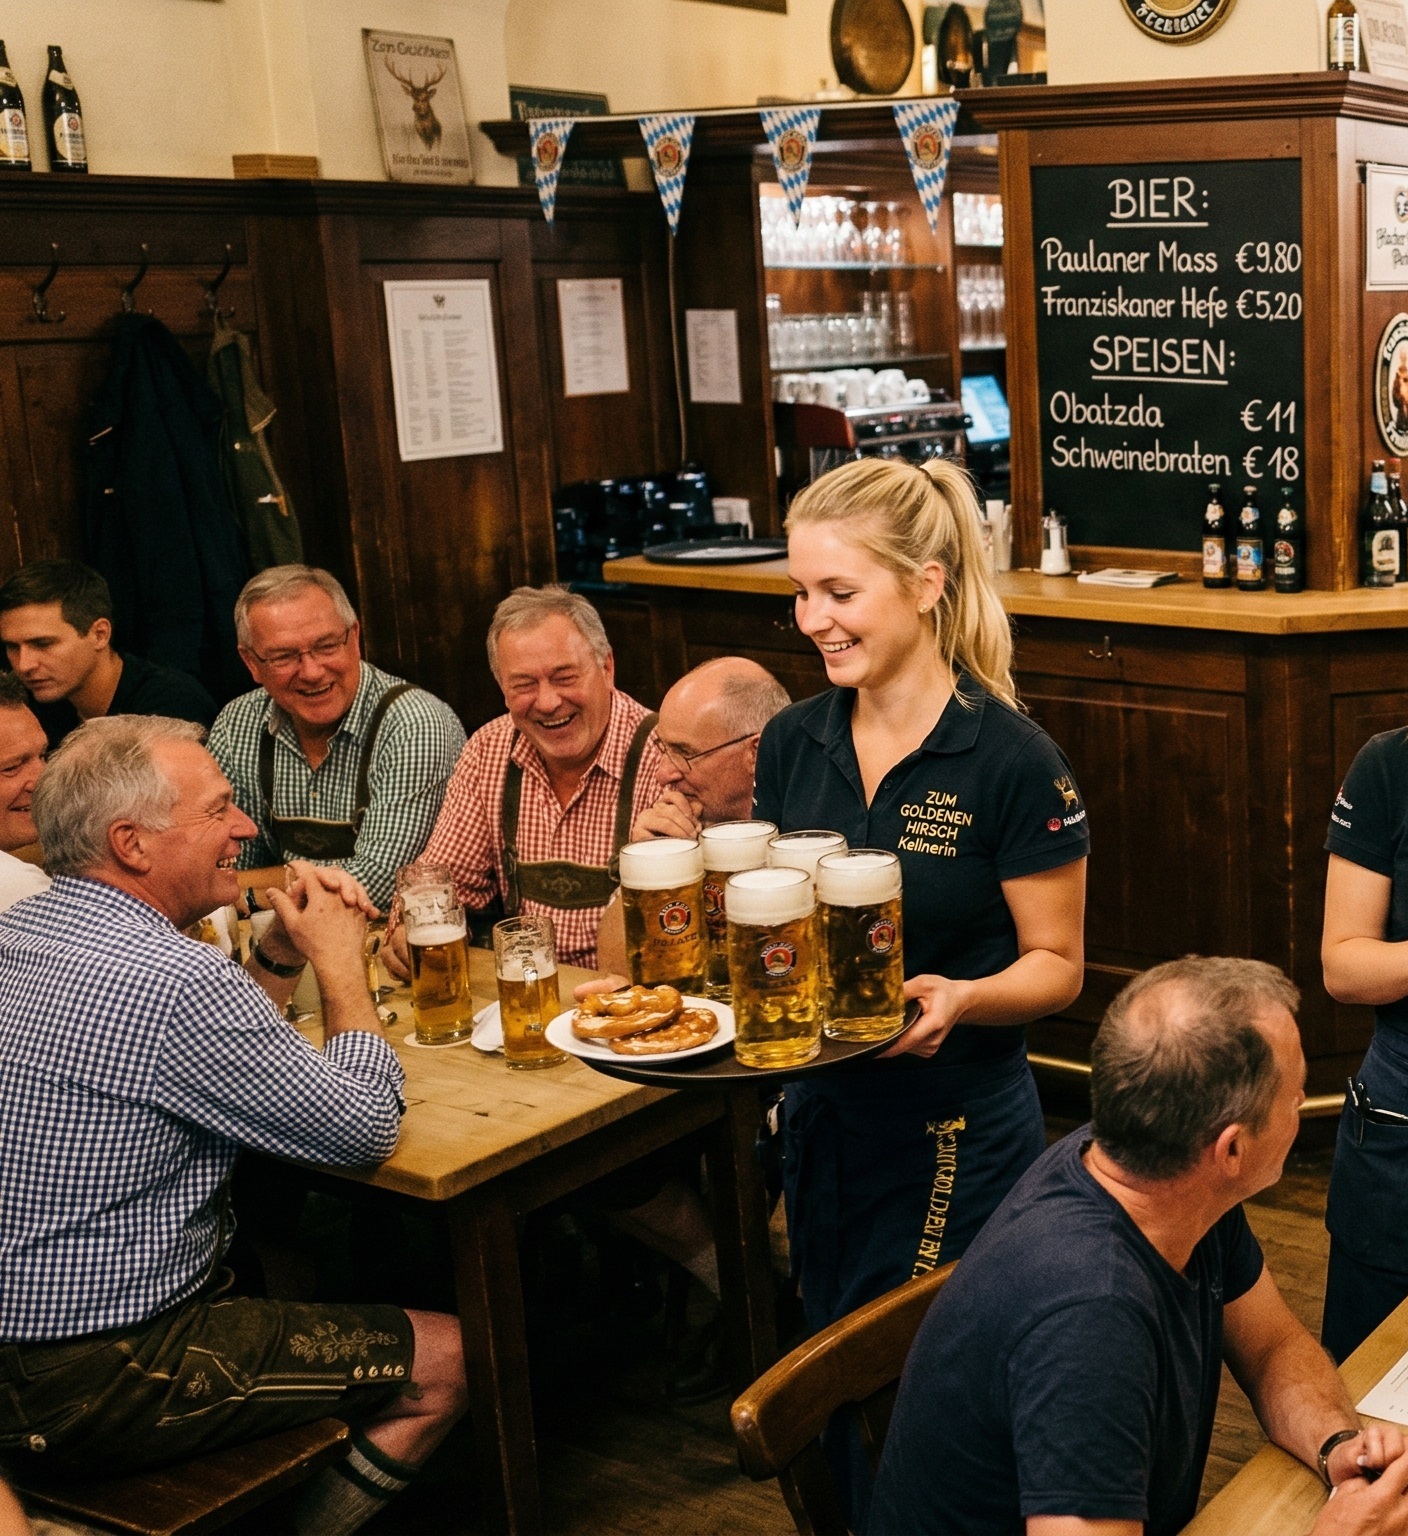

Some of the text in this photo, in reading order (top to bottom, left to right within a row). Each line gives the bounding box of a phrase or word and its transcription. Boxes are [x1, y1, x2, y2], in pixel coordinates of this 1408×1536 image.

[1107, 176, 1209, 219] BIER:
[1040, 237, 1151, 273] Paulaner
[1158, 240, 1218, 273] Mass
[1040, 285, 1176, 318] Franziskaner
[1181, 285, 1228, 328] Hefe
[1090, 335, 1236, 375] SPEISEN:
[1049, 390, 1165, 428] Obatzda
[1051, 435, 1232, 477] Schweinebraten
[900, 804, 972, 826] GOLDENEN
[925, 791, 957, 807] ZUM
[897, 836, 956, 857] Kellnerin
[905, 820, 958, 840] HIRSCH
